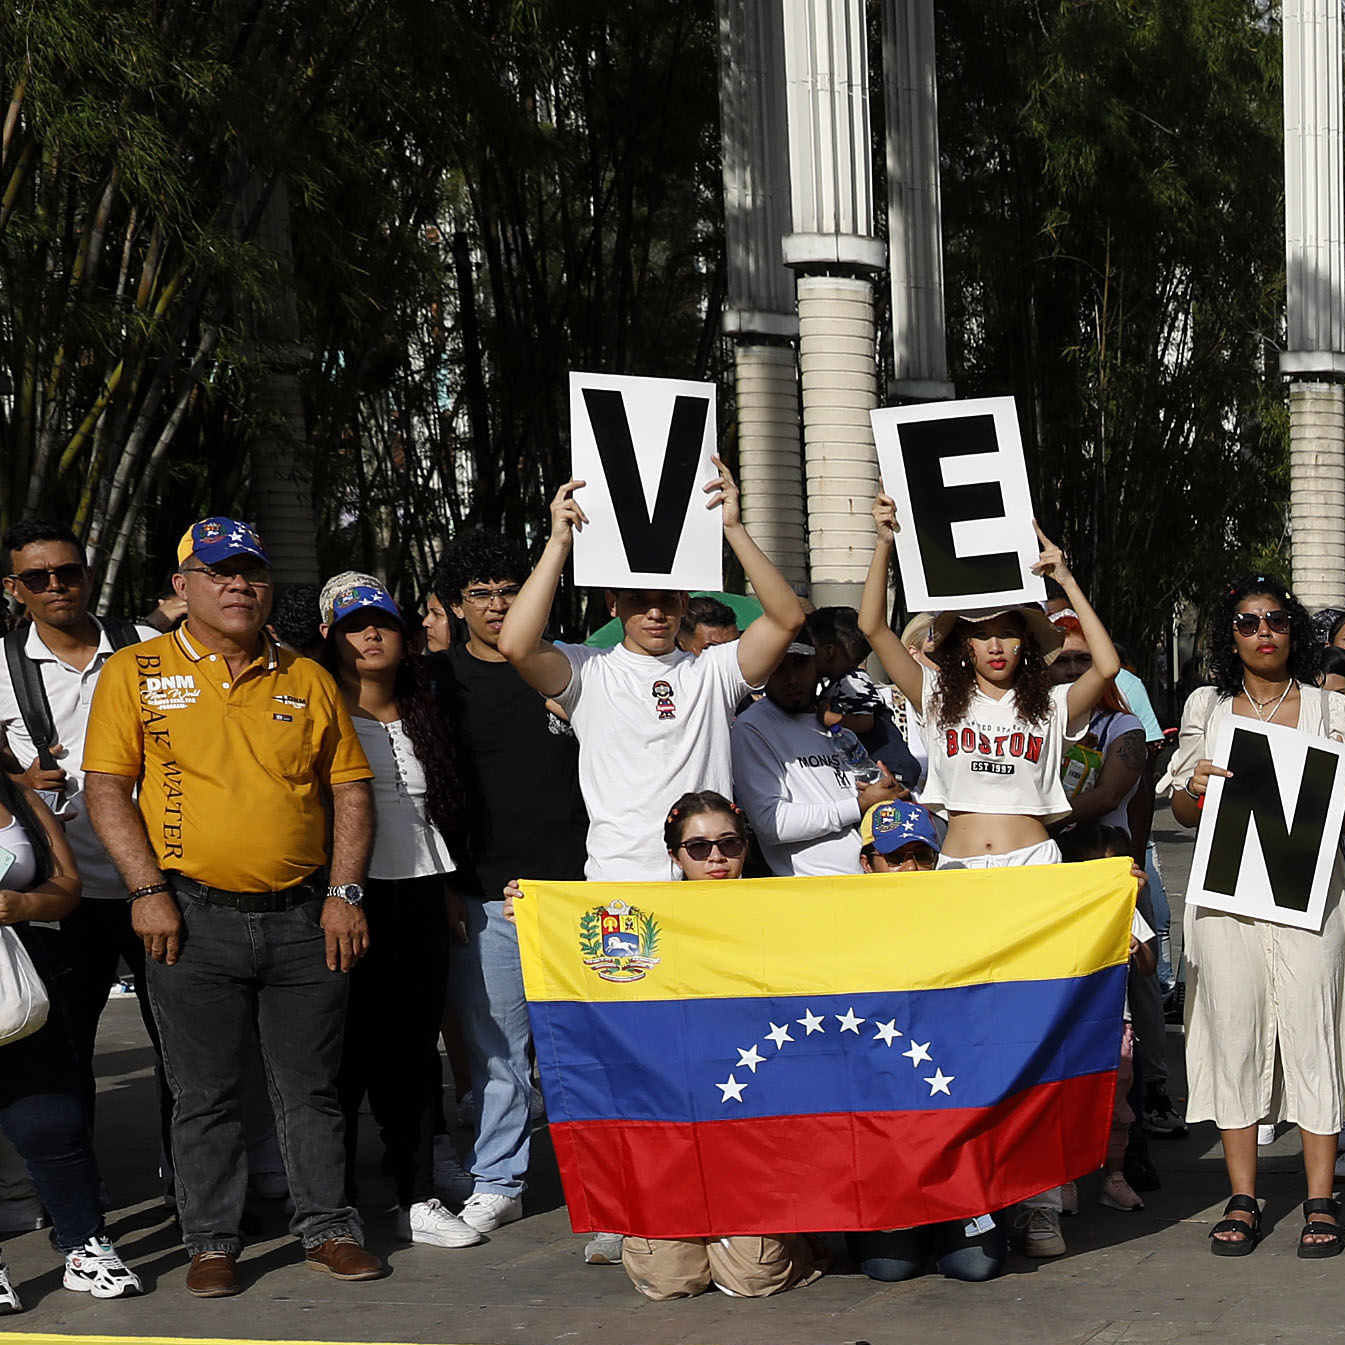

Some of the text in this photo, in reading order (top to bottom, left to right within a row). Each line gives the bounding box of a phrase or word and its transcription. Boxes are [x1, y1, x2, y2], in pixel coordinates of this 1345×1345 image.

[582, 388, 709, 574] V
[897, 414, 1024, 597] E
[146, 675, 195, 691] DNM
[946, 727, 1043, 764] BOSTON
[972, 762, 1013, 773] EST 1997
[161, 760, 184, 860] WATER
[1201, 728, 1339, 912] N
